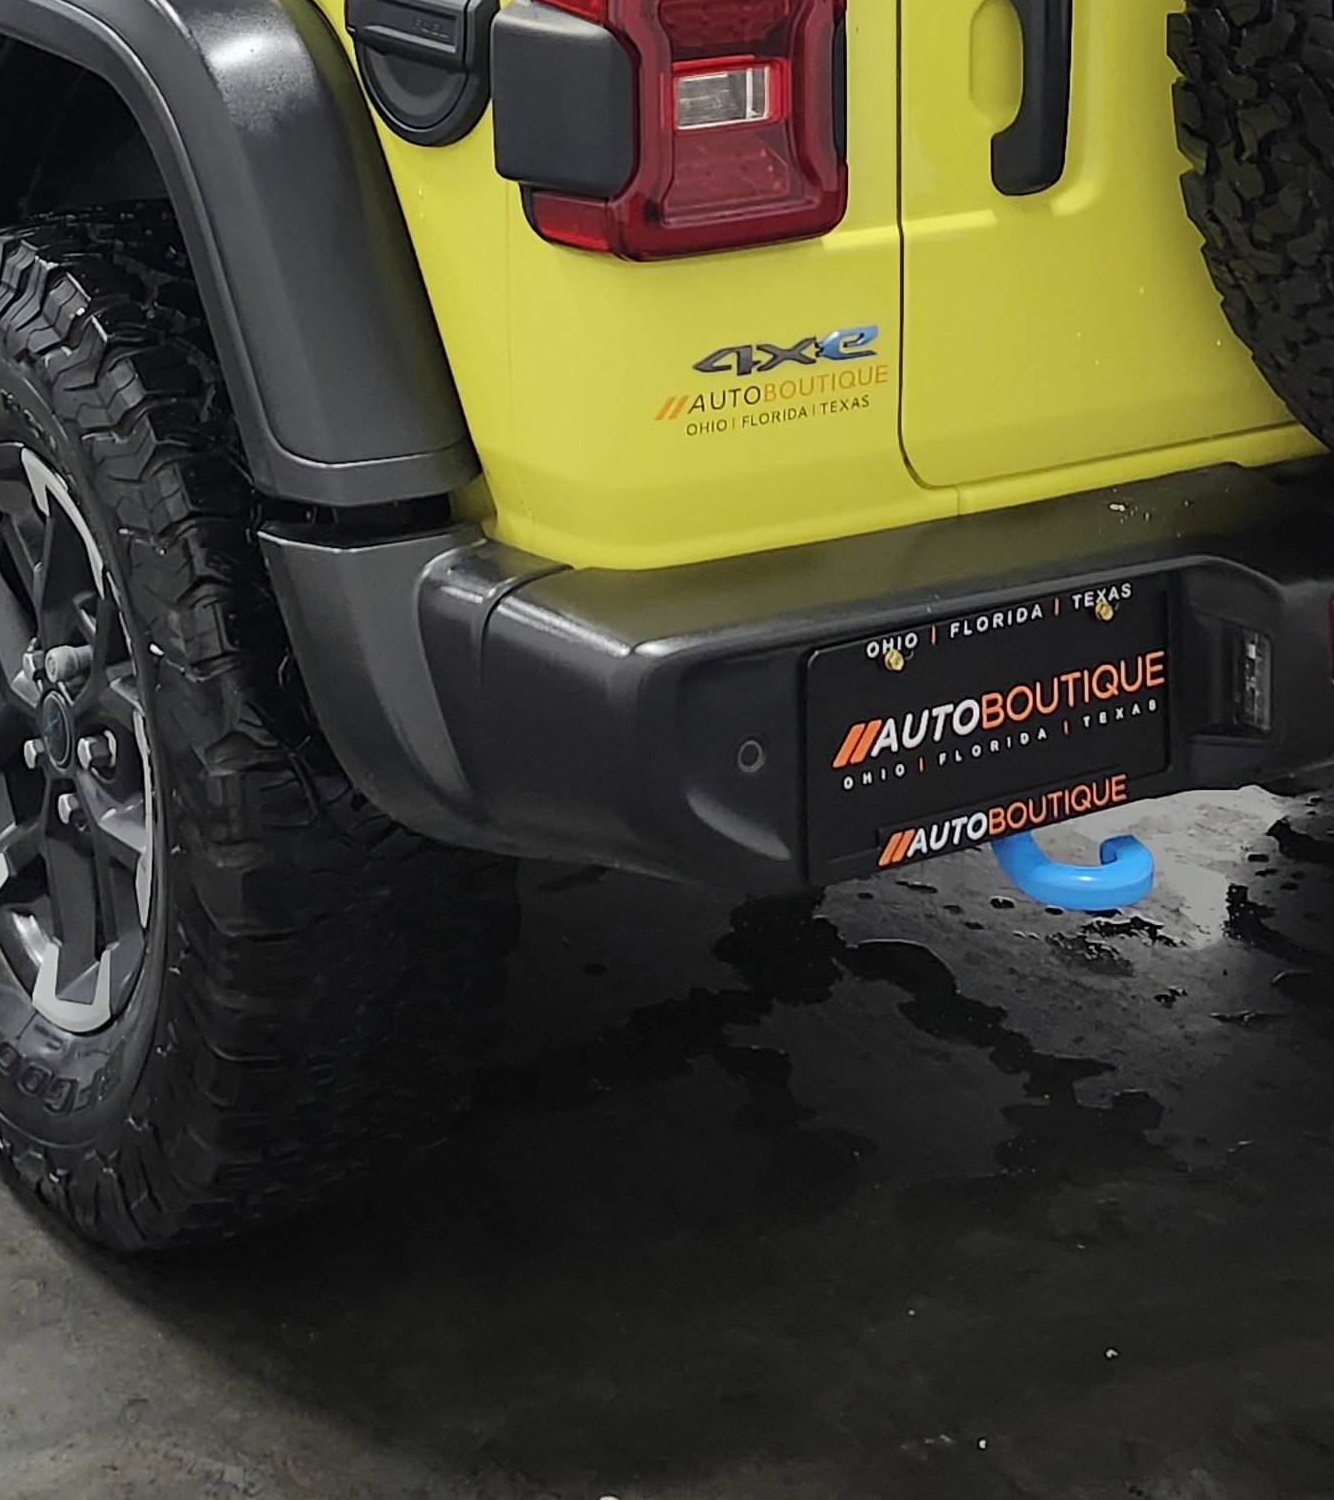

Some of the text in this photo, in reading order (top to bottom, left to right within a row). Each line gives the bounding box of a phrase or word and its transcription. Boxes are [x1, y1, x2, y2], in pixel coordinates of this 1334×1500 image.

[686, 393, 871, 437] OHIO FLORIDA TEXAS
[687, 364, 889, 415] AUTOBOUTIQUE
[866, 582, 1133, 659] OHIO FLORIDA TEXAS
[870, 649, 1166, 758] AUTOBOUTIQUE
[842, 698, 1158, 791] OHIO FLORIDA TEXAS
[905, 773, 1128, 859] AUTOBOUTIQUE
